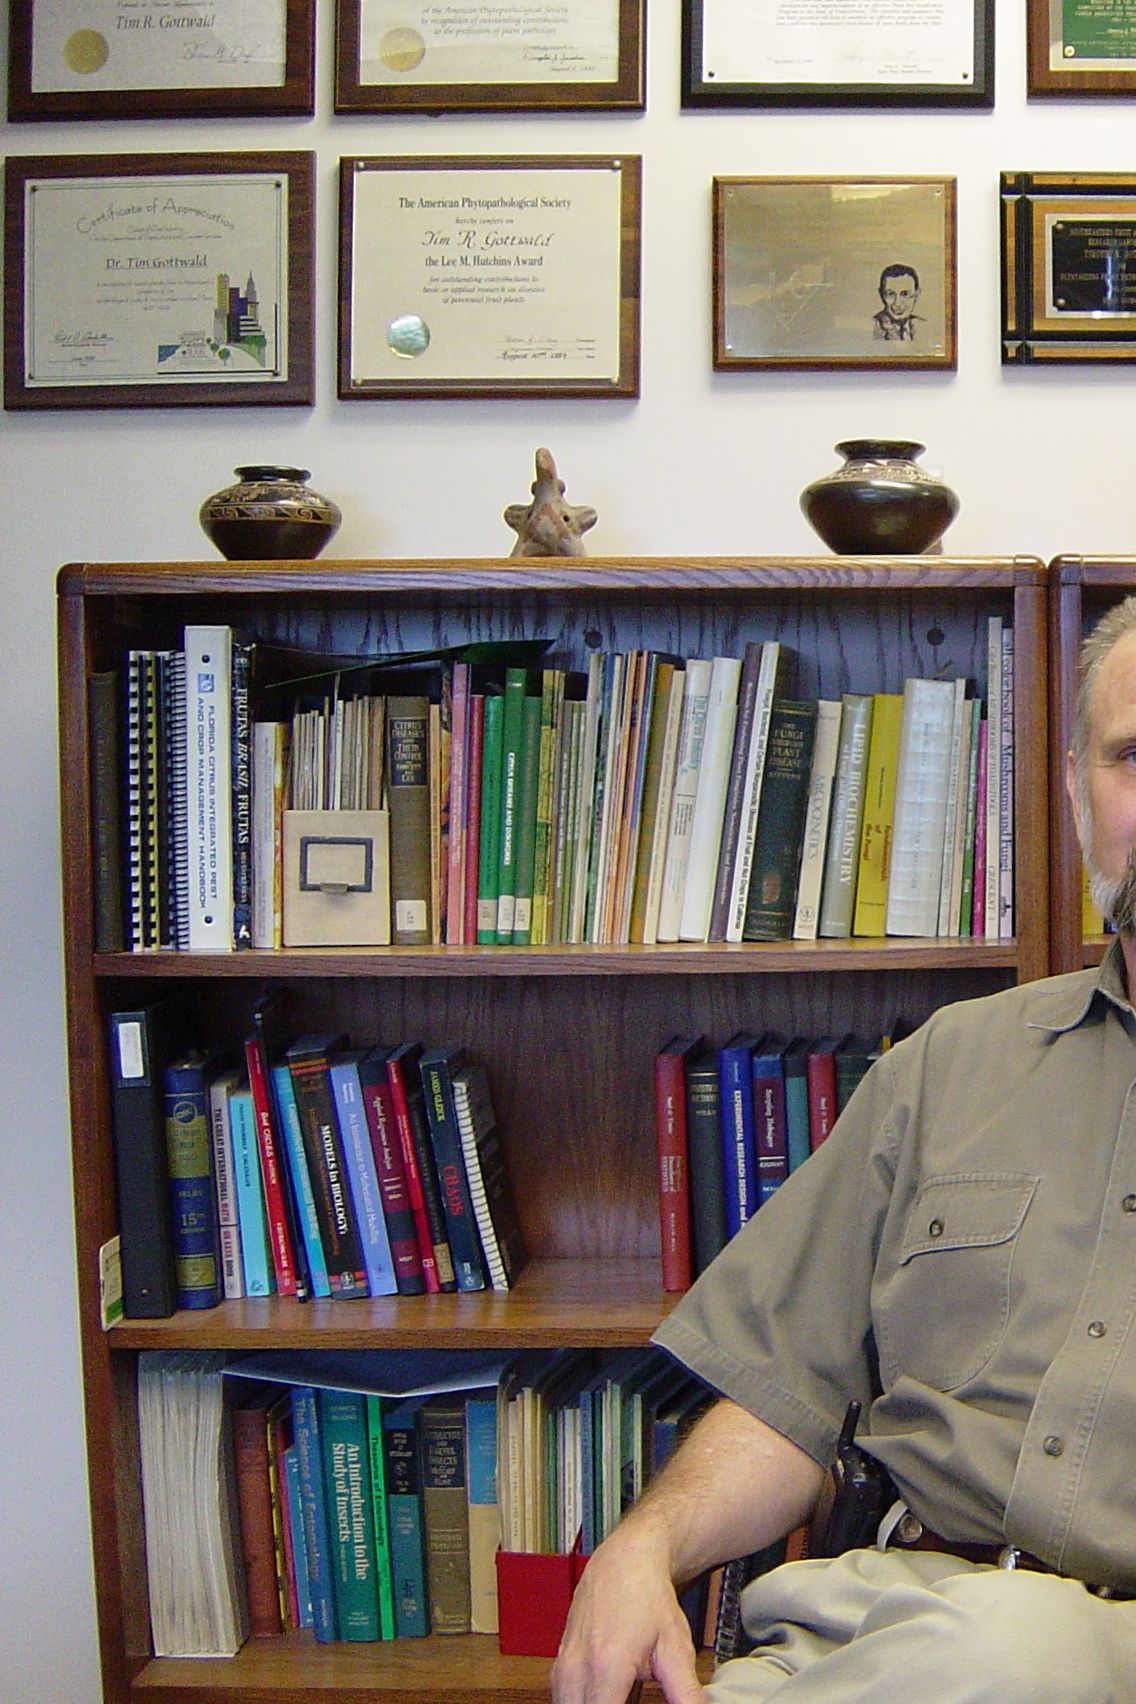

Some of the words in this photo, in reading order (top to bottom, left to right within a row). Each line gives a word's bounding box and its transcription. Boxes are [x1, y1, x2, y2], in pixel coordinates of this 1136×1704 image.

[115, 15, 140, 29] Tim
[143, 15, 155, 29] R.
[159, 14, 215, 29] Gottwald
[76, 200, 142, 234] Certificate
[147, 197, 159, 214] of
[162, 198, 235, 230] Appreciation
[399, 197, 415, 209] The
[417, 197, 459, 209] American
[461, 197, 538, 209] Phytopathological
[540, 197, 571, 209] Society
[422, 230, 450, 246] Tim
[480, 231, 555, 250] Gottwald
[106, 258, 123, 270] Dr.
[128, 257, 150, 268] Tim
[153, 255, 207, 268] Gottwald
[425, 256, 439, 267] the
[441, 256, 457, 267] Lee
[459, 256, 470, 267] M.
[473, 256, 511, 267] Hutchins
[513, 256, 543, 267] Award
[197, 697, 205, 722] AND
[236, 687, 249, 738] FRUTAS
[197, 724, 205, 756] CROP
[208, 705, 216, 752] FLORIDA
[852, 722, 867, 764] LIPID
[1001, 744, 1014, 812] Mushrooms
[198, 760, 206, 842] MANAGEMENT
[238, 794, 250, 844] FRUTAS
[209, 799, 217, 868] INTEGRATED
[840, 770, 862, 885] BIOCHEMISTRY
[199, 845, 207, 909] HANDBOOK
[210, 872, 218, 899] PEST
[214, 1109, 223, 1123] THE
[734, 1090, 744, 1142] EXPERIMENTAL
[321, 1124, 337, 1170] MODELS
[430, 1071, 441, 1094] JAMES
[443, 1165, 464, 1216] CHAOS
[737, 1142, 746, 1178] RESEARCH
[329, 1170, 339, 1183] in
[739, 1178, 748, 1206] DESIGN
[331, 1183, 349, 1235] BIOLOGY:
[740, 1206, 748, 1221] and
[296, 1398, 307, 1424] The
[332, 1443, 347, 1481] Study
[347, 1443, 360, 1462] An
[370, 1435, 380, 1482] Thesaurus
[303, 1484, 315, 1498] of
[336, 1481, 349, 1493] of
[349, 1463, 367, 1543] Introduction
[372, 1484, 382, 1493] of
[338, 1497, 351, 1542] Insects
[374, 1495, 385, 1548] Entomology
[306, 1502, 321, 1580] Entomology
[355, 1544, 368, 1558] to
[356, 1559, 369, 1581] the
